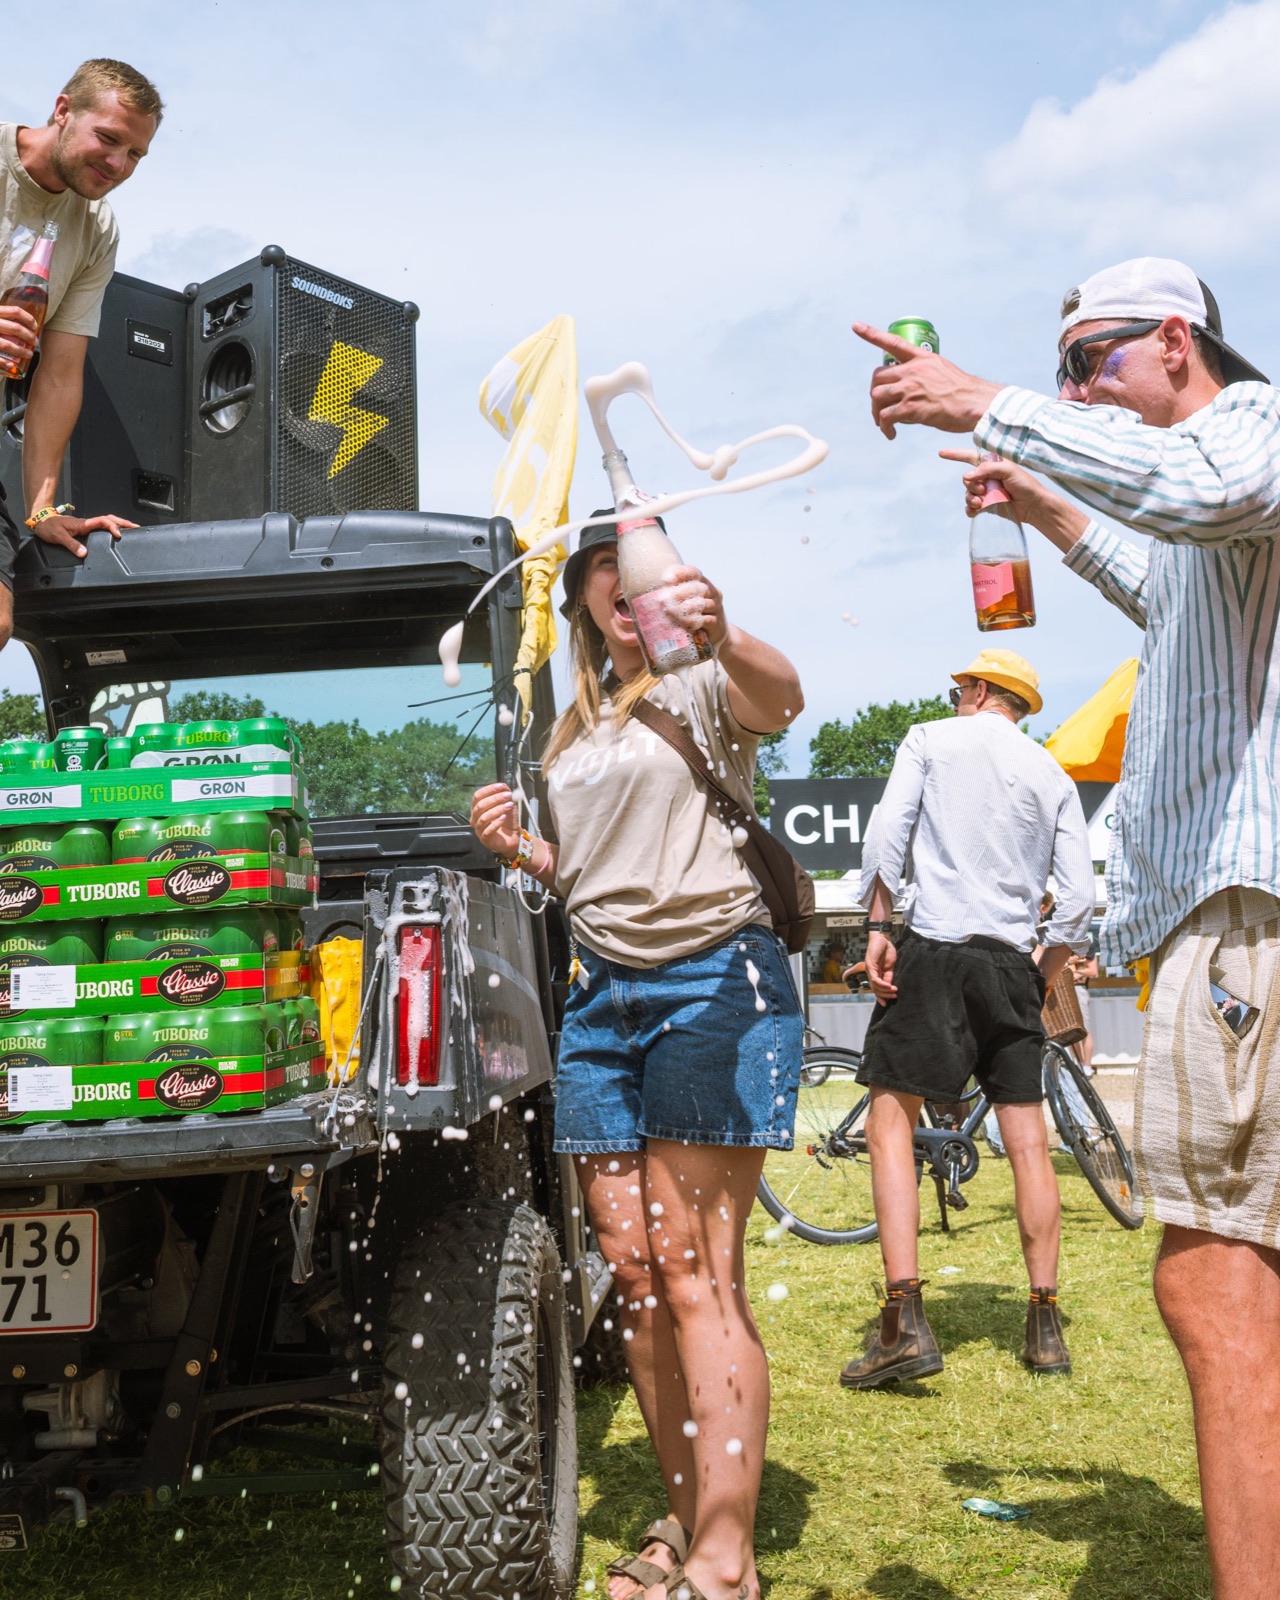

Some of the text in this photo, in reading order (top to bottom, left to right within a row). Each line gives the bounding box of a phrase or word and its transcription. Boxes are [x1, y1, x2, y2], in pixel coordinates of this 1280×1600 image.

[291, 276, 354, 310] SOUNDBOKS
[174, 730, 232, 746] TUBORG
[29, 758, 54, 770] TU
[6, 781, 246, 806] GRØN TUBORG GRØN
[155, 824, 212, 840] TUBORG
[784, 804, 880, 845] CH
[67, 869, 224, 902] TUBORG Classic
[286, 872, 306, 890] TUBORG
[153, 928, 209, 942] TUBORG
[1, 937, 47, 953] UBORG
[76, 979, 134, 1000] UBORG
[162, 969, 219, 995] Classic
[0, 1036, 47, 1052] UBORG
[114, 1030, 120, 1042] 6
[152, 1028, 209, 1042] TUBORG
[286, 1061, 311, 1084] TUBORG
[72, 1082, 132, 1102] UBORG
[160, 1072, 218, 1098] Classic
[1, 1274, 52, 1322] 71
